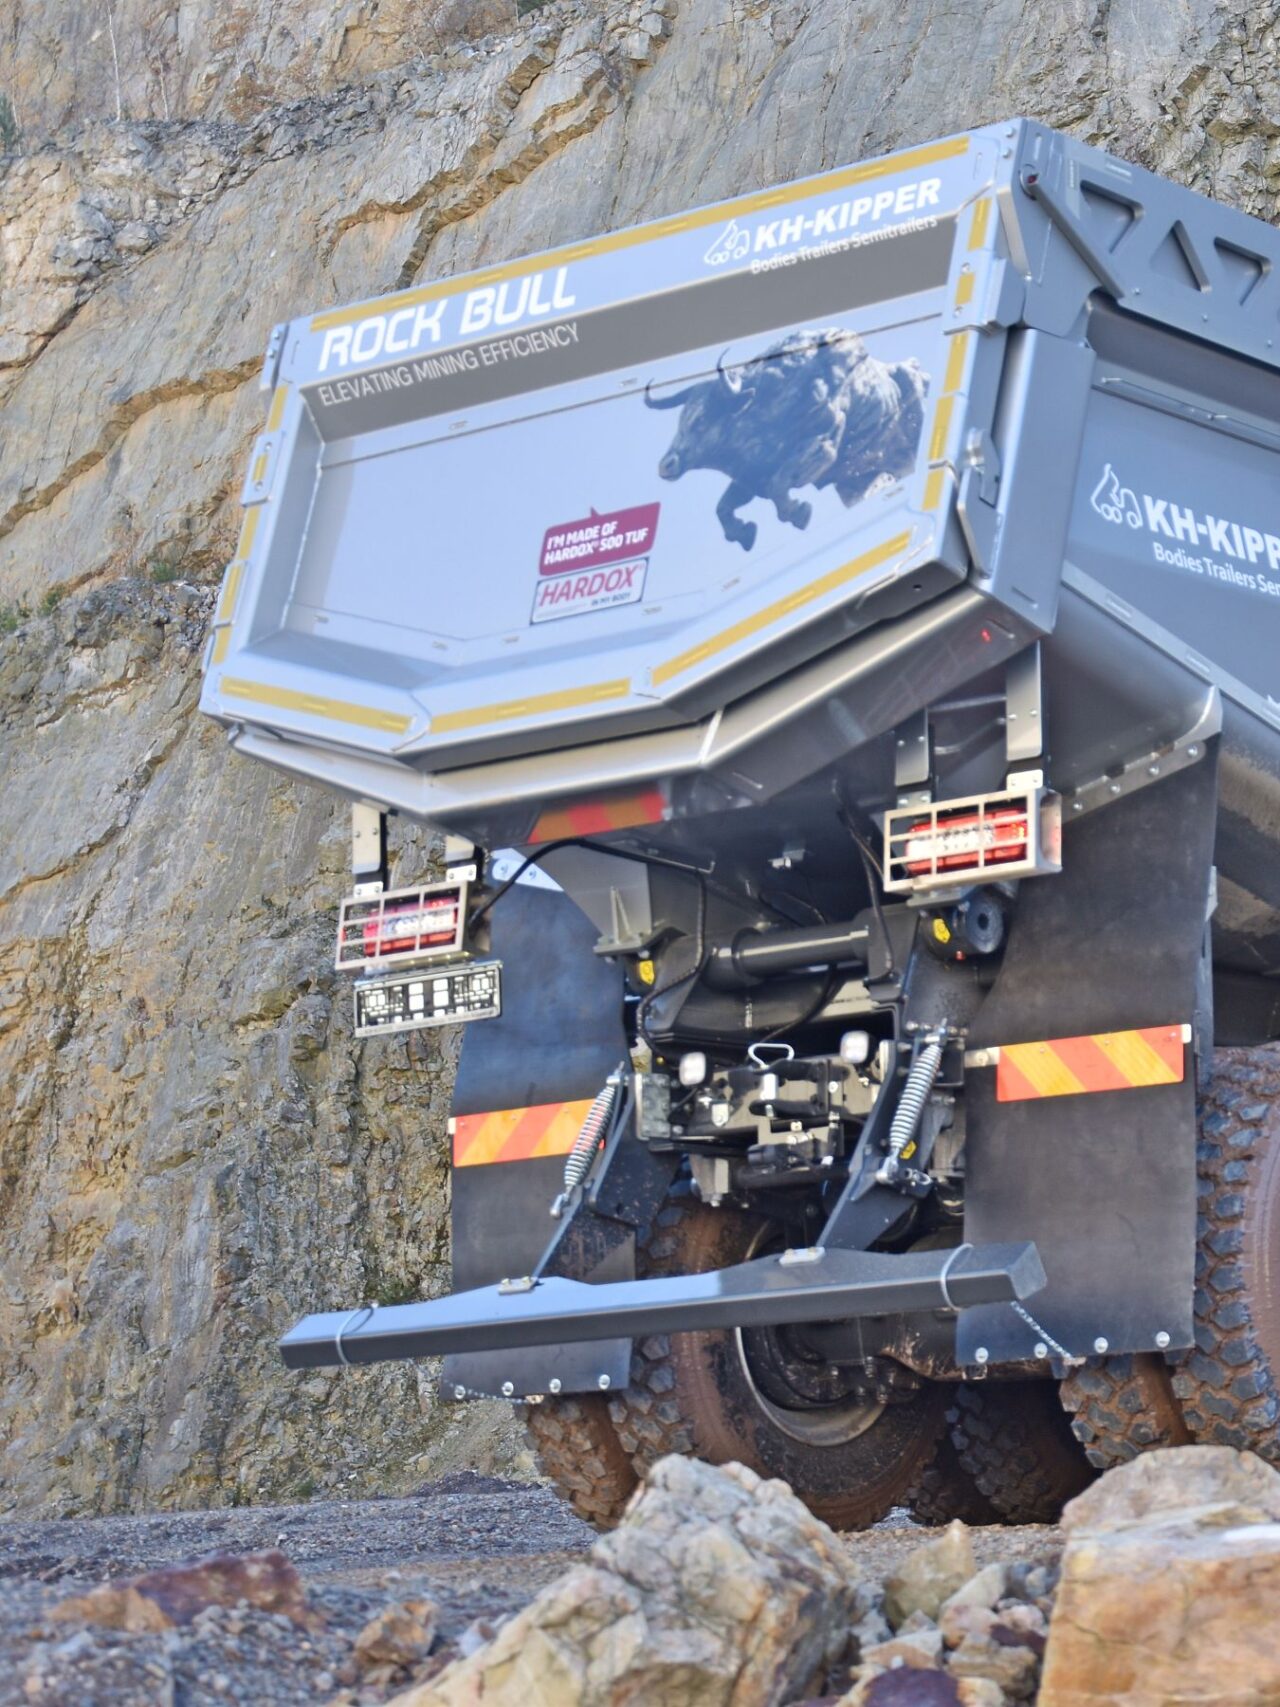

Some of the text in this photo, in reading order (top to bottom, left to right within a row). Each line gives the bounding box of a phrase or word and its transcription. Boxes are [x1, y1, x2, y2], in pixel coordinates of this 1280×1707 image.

[750, 213, 939, 275] Bodies Trailers Semitrailers
[753, 177, 942, 253] KH-KIPPER
[317, 266, 577, 372] ROCK BULL
[317, 321, 580, 407] ELEVATING MINING EFFICIENCY
[547, 521, 618, 550] I'M MADE OF
[625, 528, 648, 544] TUF
[1153, 541, 1203, 574] Bodies
[1203, 557, 1256, 590] Trailers
